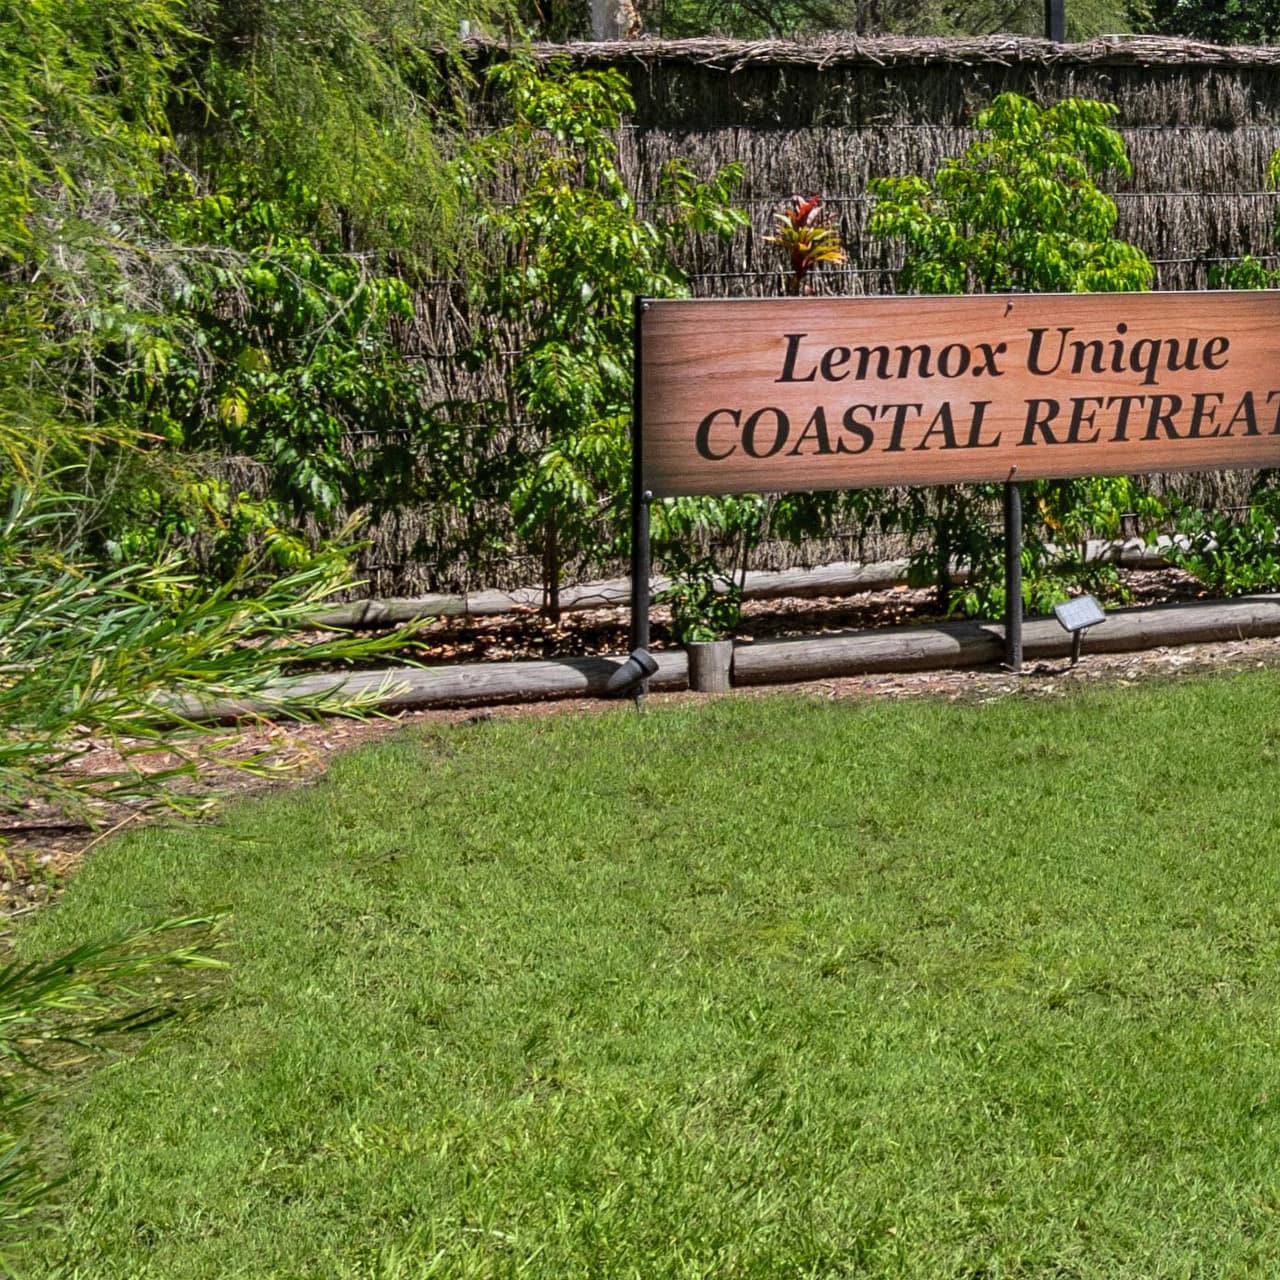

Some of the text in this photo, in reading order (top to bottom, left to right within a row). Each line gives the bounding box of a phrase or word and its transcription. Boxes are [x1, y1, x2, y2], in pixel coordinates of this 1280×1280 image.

[774, 322, 1230, 386] Lennox Unique
[694, 400, 1002, 461] COASTAL
